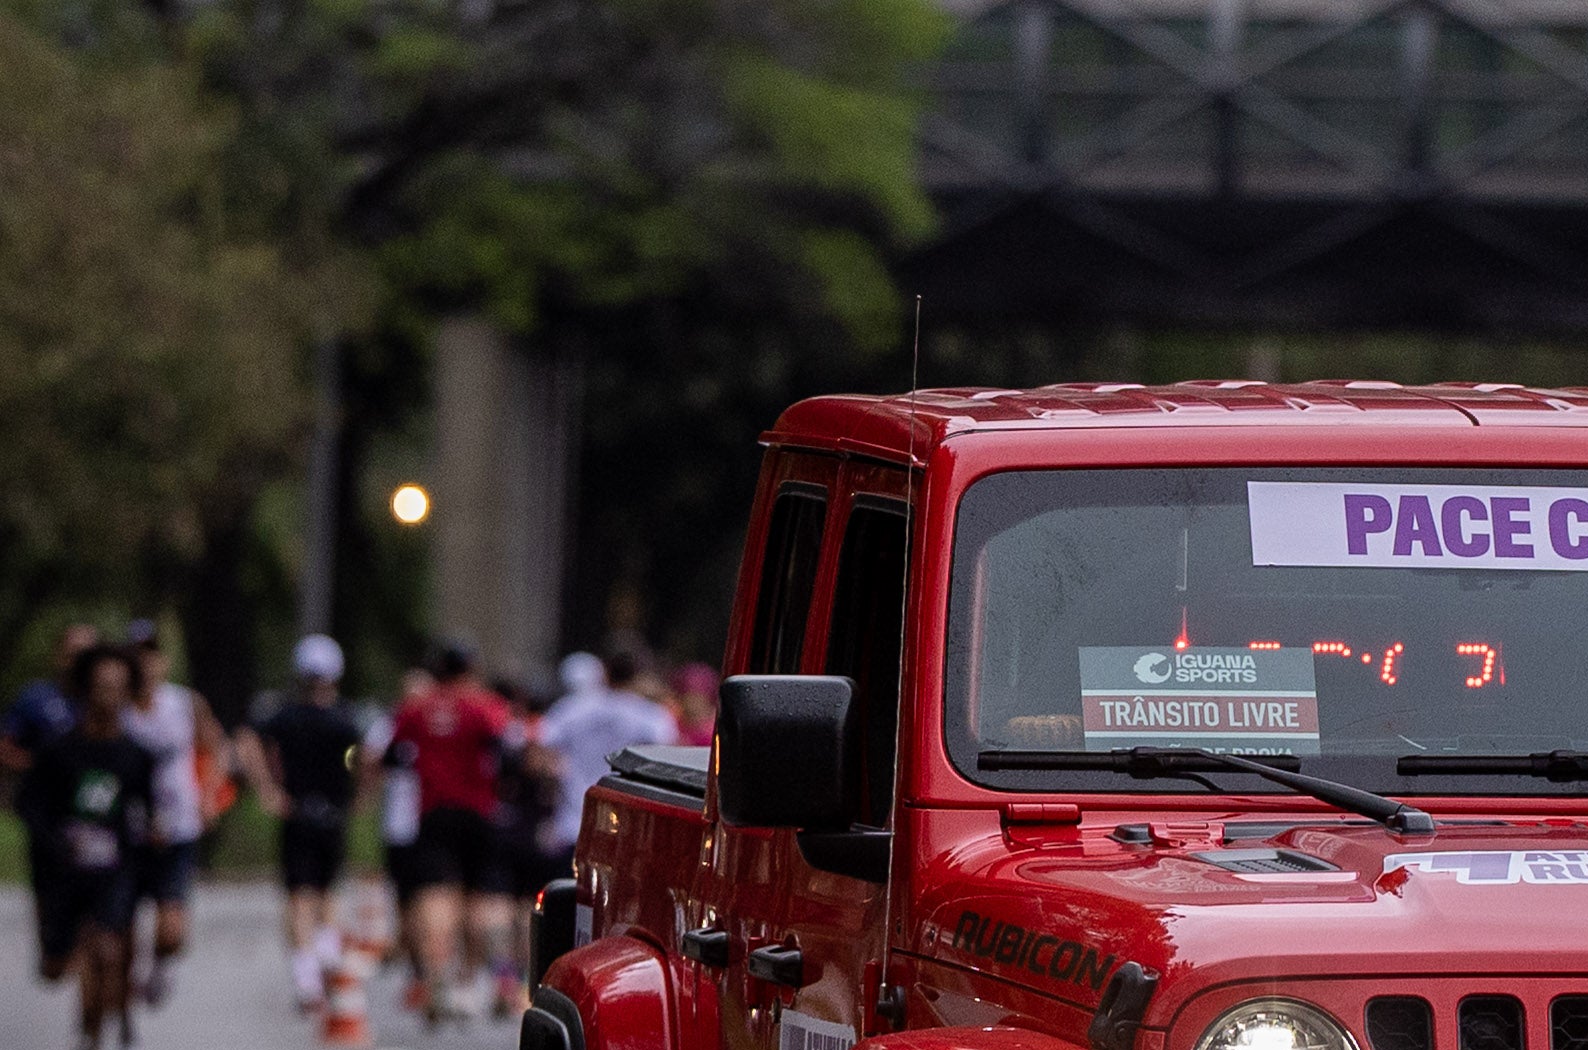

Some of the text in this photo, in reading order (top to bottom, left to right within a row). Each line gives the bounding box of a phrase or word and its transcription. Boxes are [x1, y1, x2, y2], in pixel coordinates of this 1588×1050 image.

[1343, 494, 1535, 558] PACE
[1175, 654, 1256, 669] IGUANA
[1175, 668, 1257, 683] SPORTS
[1099, 696, 1300, 728] TRÂNSITO LIVRE
[952, 910, 1117, 991] RUBICON
